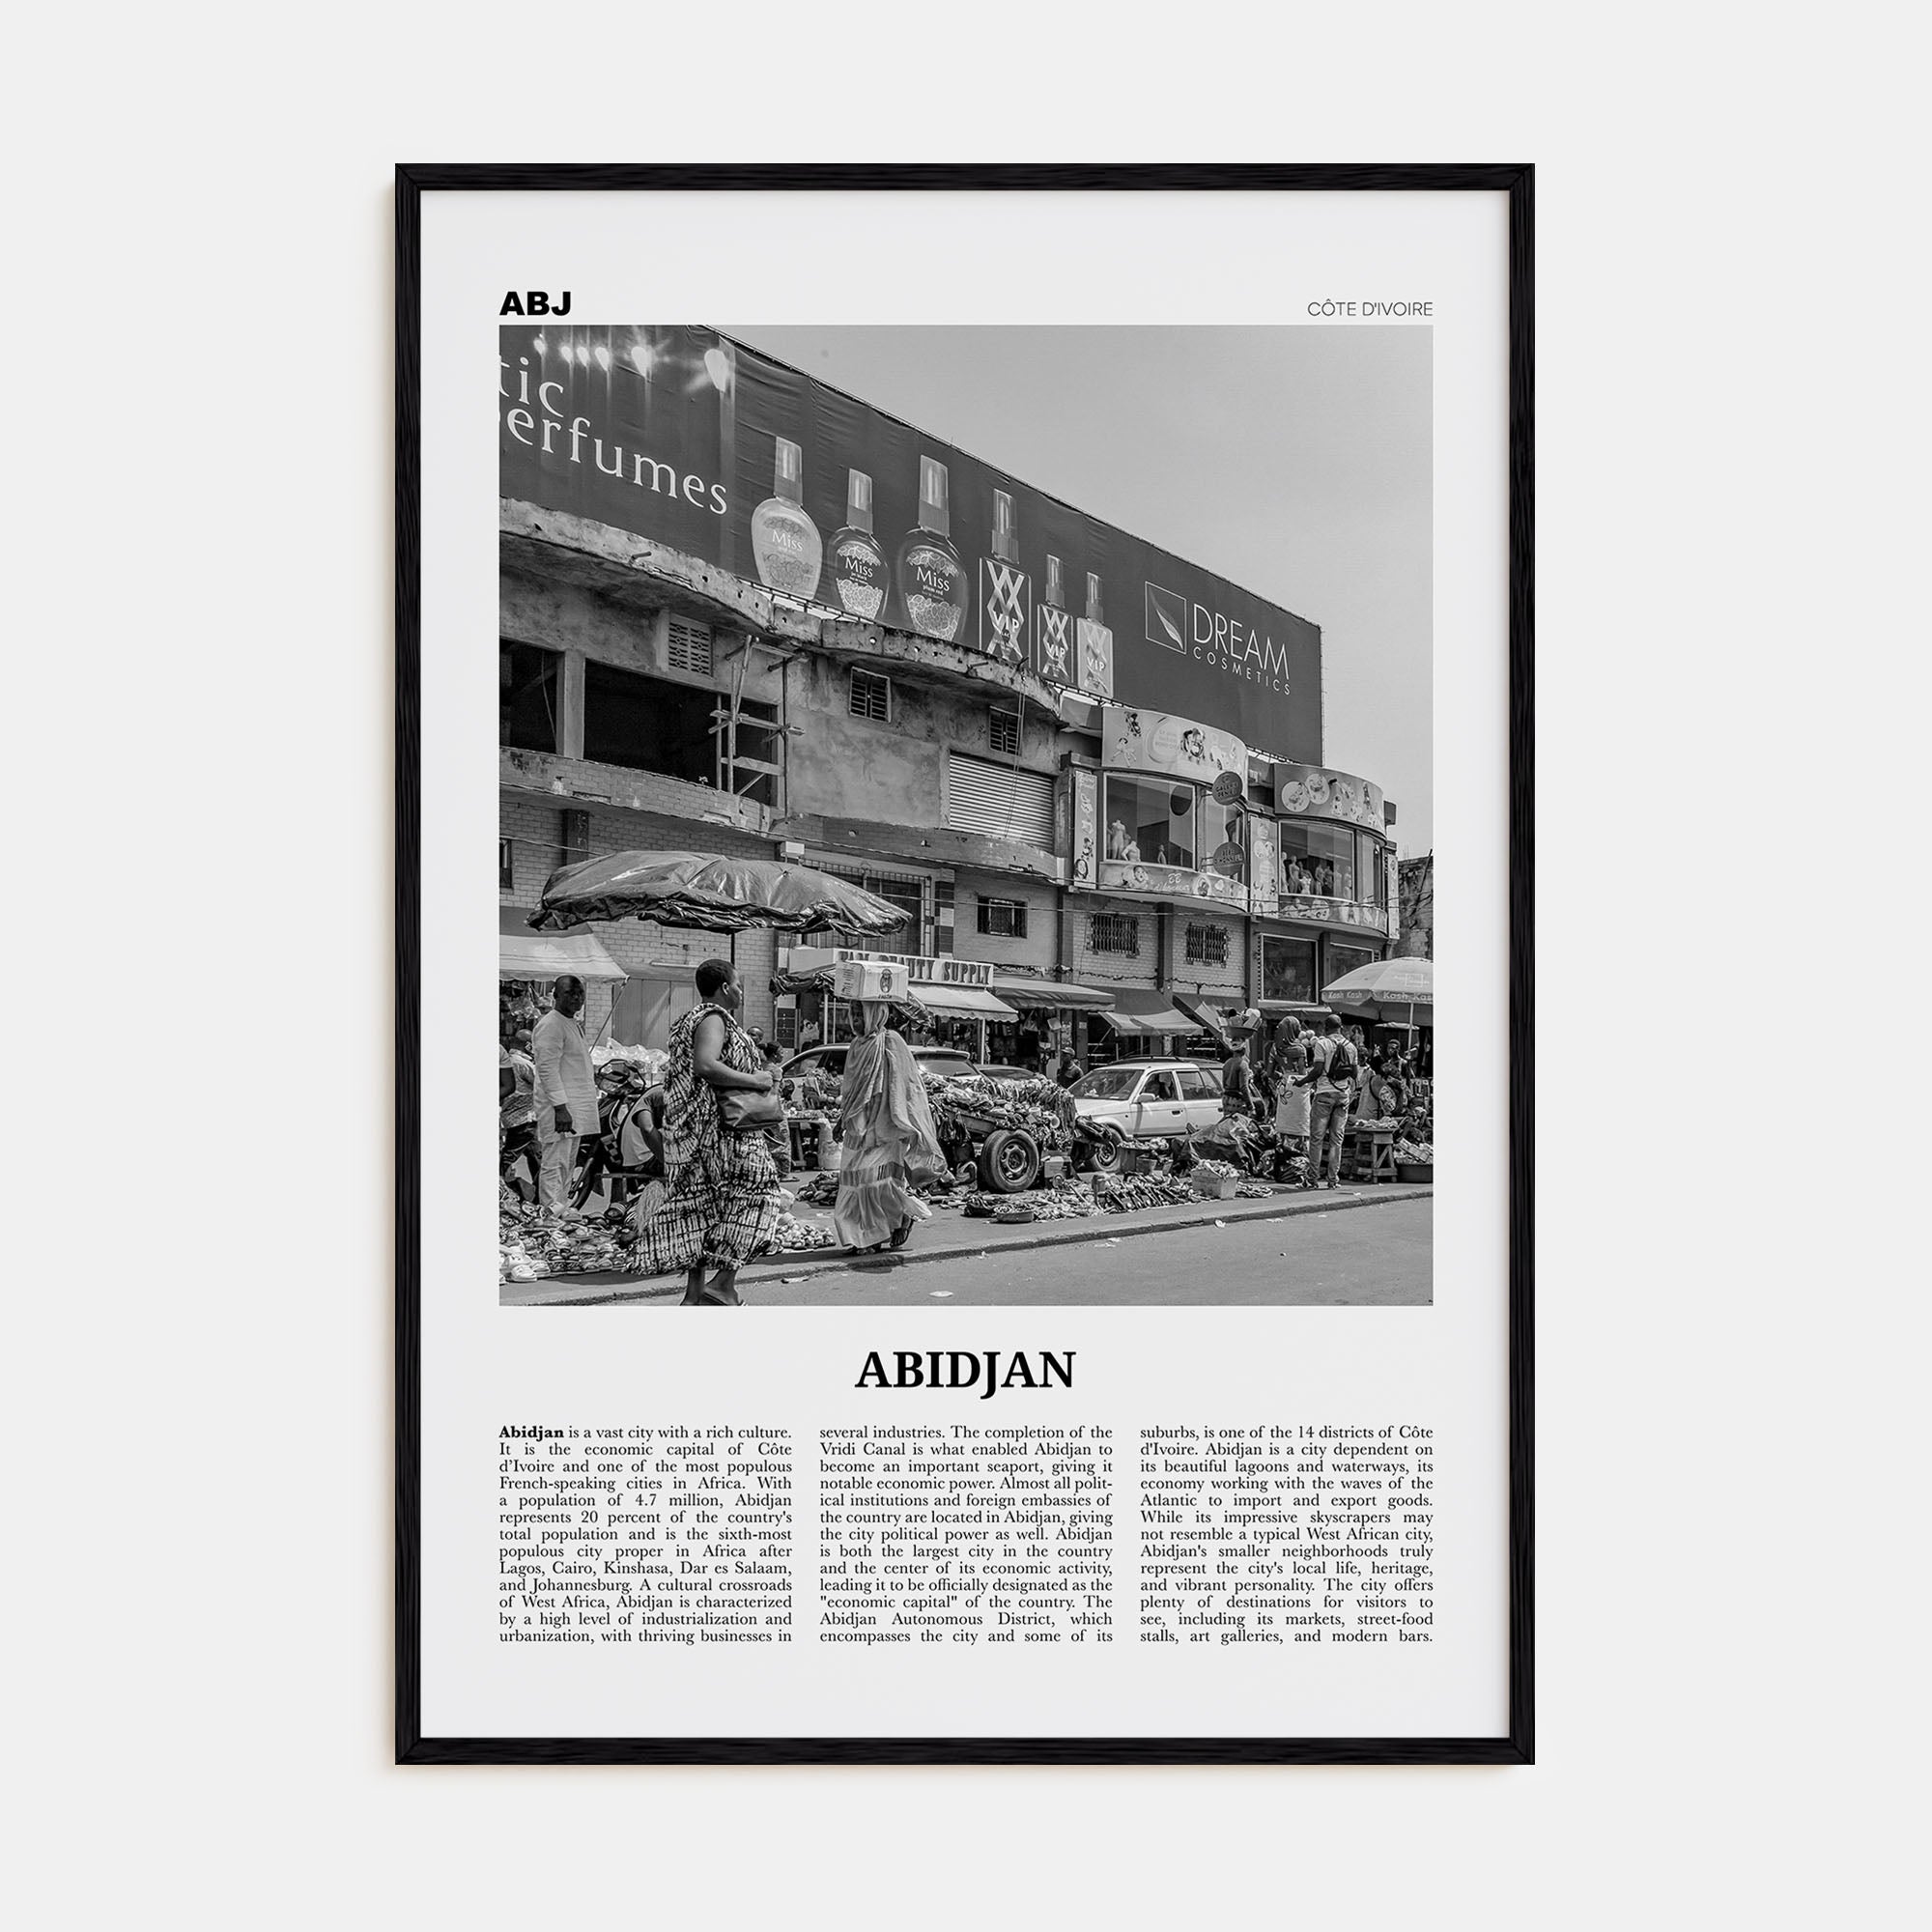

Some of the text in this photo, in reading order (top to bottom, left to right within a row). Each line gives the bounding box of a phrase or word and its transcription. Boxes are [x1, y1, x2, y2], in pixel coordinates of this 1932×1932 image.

[499, 291, 572, 317] ABJ
[1307, 298, 1434, 317] CÔTE D'IVOIRE
[498, 408, 728, 515] erfumes
[772, 528, 804, 553] Miss
[845, 556, 873, 578] Miss
[916, 566, 951, 592] Miss
[992, 610, 1020, 633] VIP
[1046, 641, 1065, 658] VIP
[1193, 603, 1290, 680] DREAM
[1087, 656, 1106, 671] VIP
[1192, 645, 1292, 696] COSMETICS
[943, 961, 992, 985] SUPPLY
[854, 1350, 1077, 1400] ABIDJAN
[498, 1426, 792, 1442] Abidjan is a vast city with a rich culture.
[819, 1426, 1113, 1442] several industries. The completion of the
[562, 1460, 589, 1472] and
[597, 1463, 623, 1472] one
[631, 1460, 648, 1472] of
[655, 1460, 678, 1472] the
[685, 1462, 720, 1472] most
[726, 1460, 793, 1476] populous
[819, 1460, 1113, 1476] become an important seaport, giving it
[1140, 1460, 1434, 1476] its beautiful lagoons and waterways, its
[498, 1493, 792, 1510] a population of 4.7 million, Abidjan
[819, 1493, 1113, 1510] ical institutions and foreign embassies of
[1140, 1493, 1434, 1510] Atlantic to import and export goods.
[499, 1527, 792, 1545] total population and is the sixth-most
[820, 1527, 1113, 1545] the city political power as well. Abidjan
[1140, 1527, 1434, 1545] not resemble a typical West African city,
[499, 1561, 792, 1578] Lagos, Cairo, Kinshasa, Dar es Salaam,
[819, 1561, 1113, 1578] and the center of its economic activity,
[1140, 1561, 1434, 1578] represent the city's local life, heritage,
[498, 1595, 792, 1612] of West Africa, Abidjan is characterized
[820, 1595, 1113, 1612] "economic capital" of the country. The
[1140, 1595, 1434, 1612] plenty of destinations for visitors to
[499, 1630, 792, 1646] urbanization, with thriving businesses in
[819, 1630, 1113, 1646] encompasses the city and some of its
[1140, 1630, 1433, 1646] stalls, art galleries, and modern bars.
